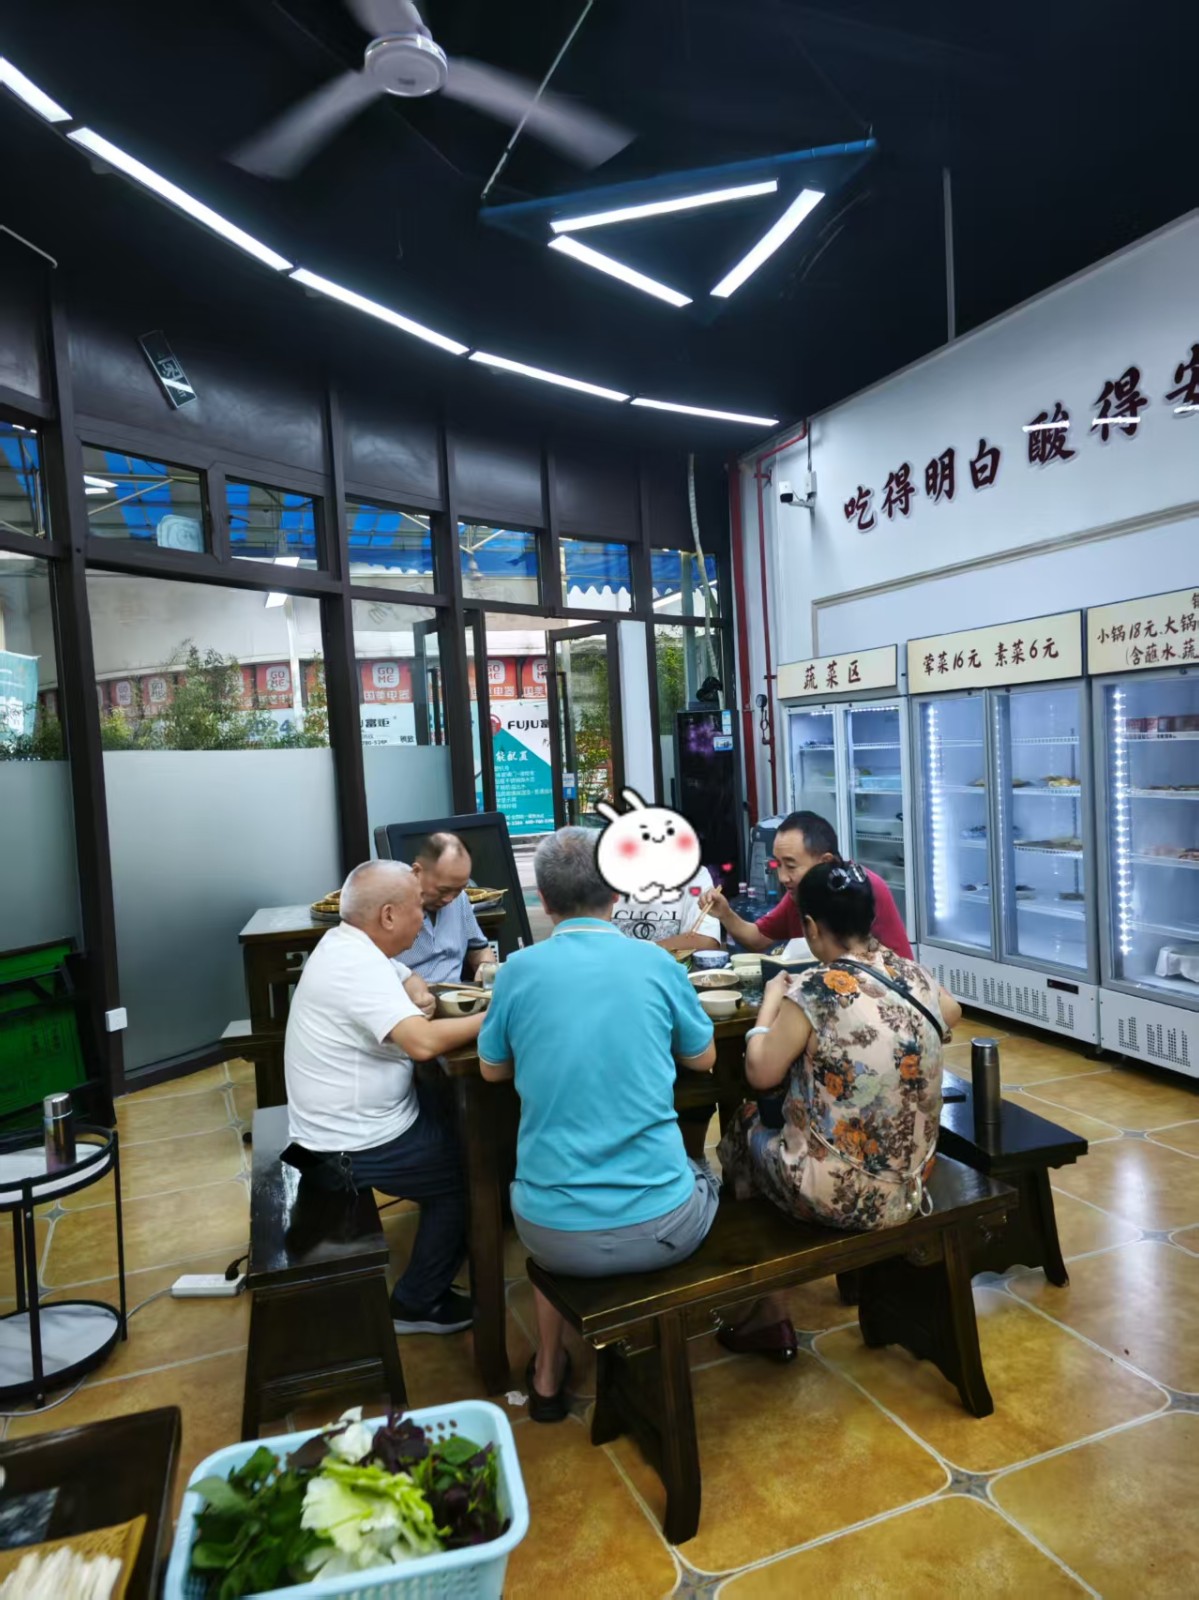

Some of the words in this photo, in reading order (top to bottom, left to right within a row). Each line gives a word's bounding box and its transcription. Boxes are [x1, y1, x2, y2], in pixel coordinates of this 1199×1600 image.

[844, 438, 1001, 531] 吃得明白
[802, 659, 862, 691] 蔬菜区
[922, 648, 982, 676] 荤菜16元
[994, 637, 1060, 668] 素菜6元
